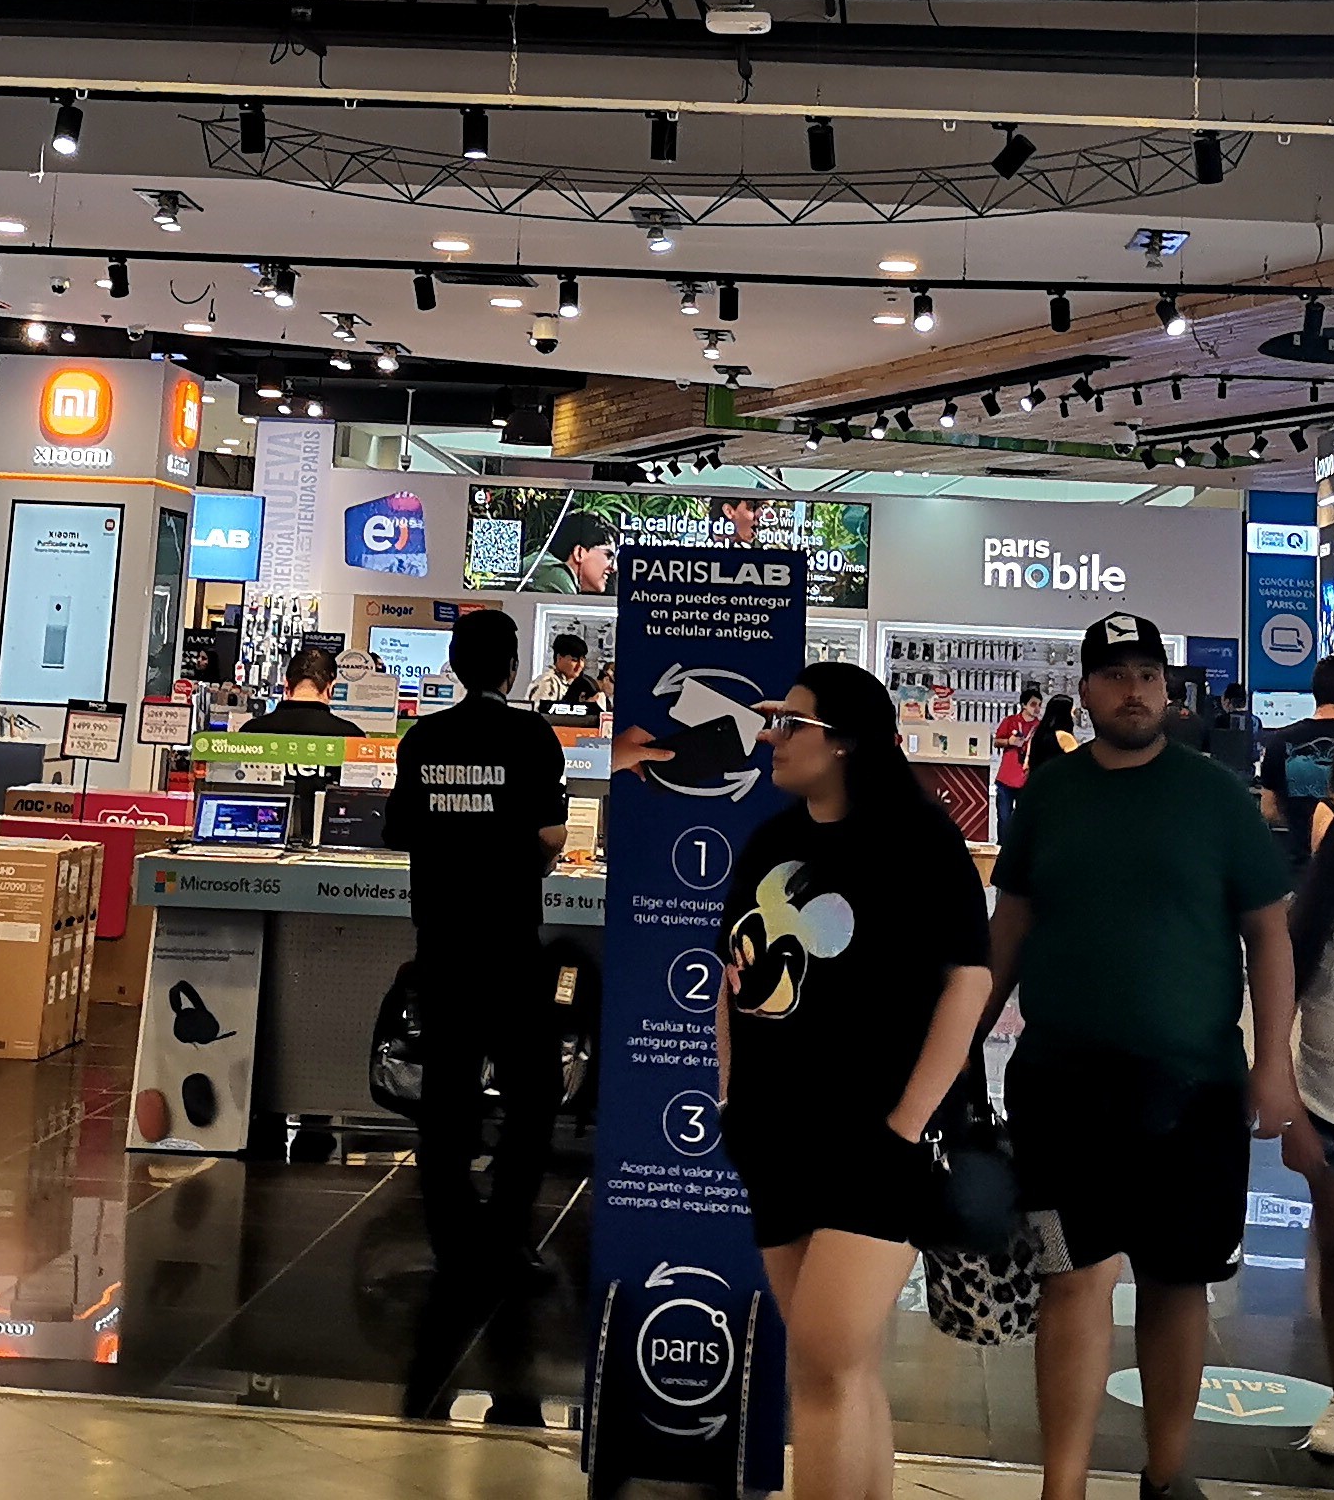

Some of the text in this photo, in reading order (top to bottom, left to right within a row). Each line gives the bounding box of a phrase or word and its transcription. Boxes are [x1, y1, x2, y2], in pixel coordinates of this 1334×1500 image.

[34, 446, 114, 466] xiaomi
[303, 429, 321, 474] PARIS
[263, 431, 303, 525] NUEVA
[620, 512, 735, 537] La calidad de
[984, 535, 1050, 561] paris
[632, 558, 791, 587] PARISLAB
[983, 552, 1127, 593] mobile
[381, 603, 414, 617] Hogar
[630, 588, 791, 612] Ahora puedes entregar
[650, 608, 770, 627] en parte de pago
[646, 622, 774, 642] tu celular antiguo.
[548, 703, 588, 716] ASUS
[210, 743, 265, 755] COTIDIANOS
[420, 764, 506, 787] SEGURIDAD
[12, 798, 44, 813] AOC
[429, 792, 495, 813] PRIVADA
[693, 840, 708, 877] 1
[180, 874, 282, 896] Microsoft 365
[317, 881, 391, 900] No olvides
[565, 894, 593, 910] a tu
[632, 895, 725, 913] Elige el equipo
[633, 914, 709, 927] que quieres
[684, 963, 711, 1001] 2
[642, 1019, 701, 1034] Evalúa tu
[626, 1036, 708, 1051] antiguo para
[631, 1053, 701, 1066] su valor de
[679, 1105, 705, 1143] 3
[620, 1160, 725, 1182] Acepta el valor y
[607, 1179, 738, 1199] como parte de pago
[607, 1195, 729, 1214] compra del equipo
[651, 1337, 720, 1367] paris
